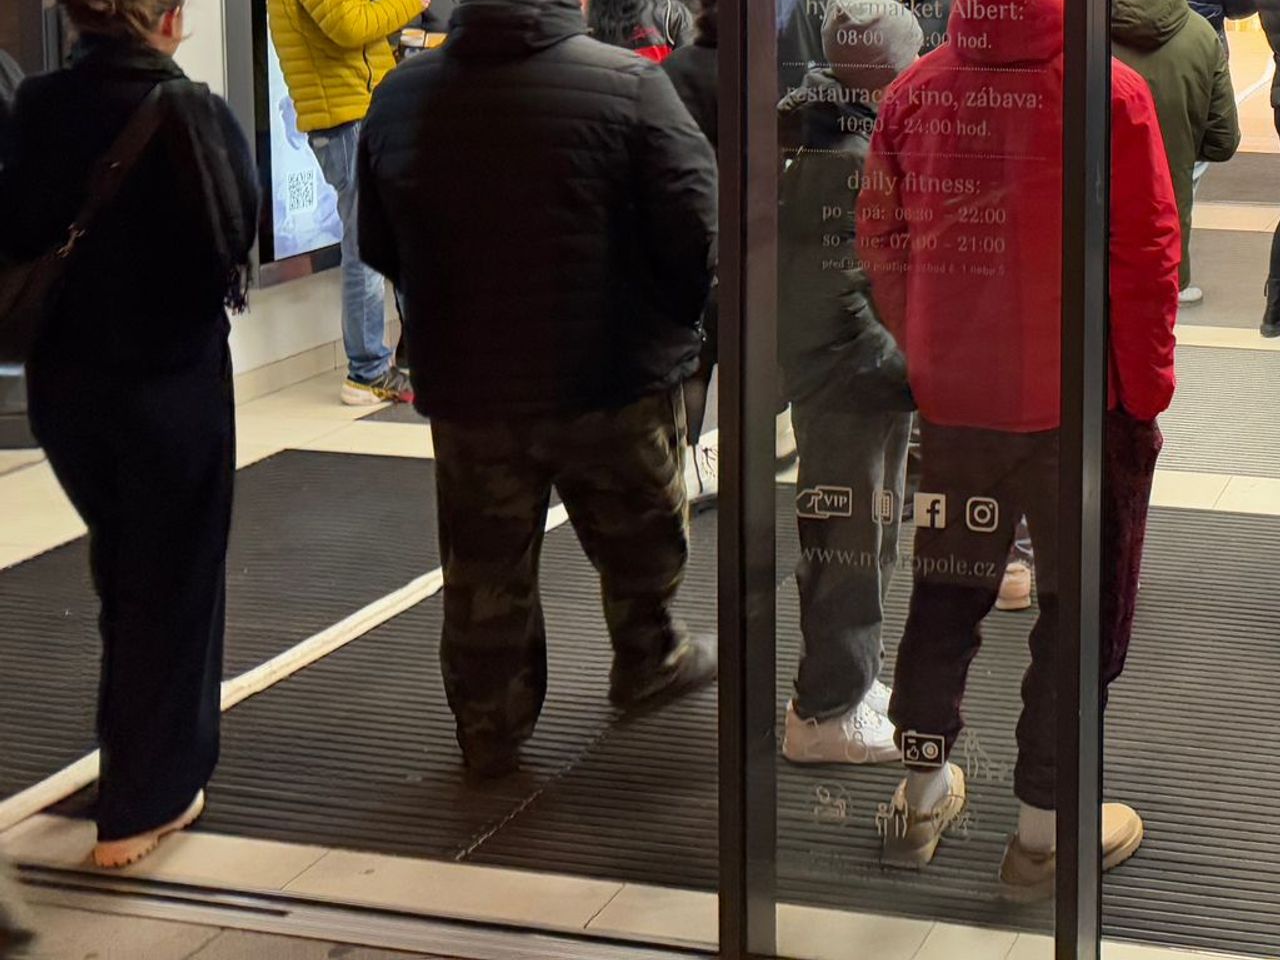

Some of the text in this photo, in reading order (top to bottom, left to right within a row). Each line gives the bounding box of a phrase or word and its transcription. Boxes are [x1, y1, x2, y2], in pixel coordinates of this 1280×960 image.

[957, 32, 992, 48] hod.
[908, 86, 959, 110] kino,
[966, 86, 1044, 109] zábava:
[837, 115, 884, 133] 10:00
[957, 118, 992, 136] hod.
[847, 170, 982, 195] daily fitness:
[822, 205, 842, 221] po
[862, 204, 886, 221] pá:
[958, 207, 1007, 224] 22:00
[822, 234, 841, 248] so
[860, 235, 885, 249] ne:
[957, 236, 1006, 253] 21:00
[824, 496, 848, 508] VIP
